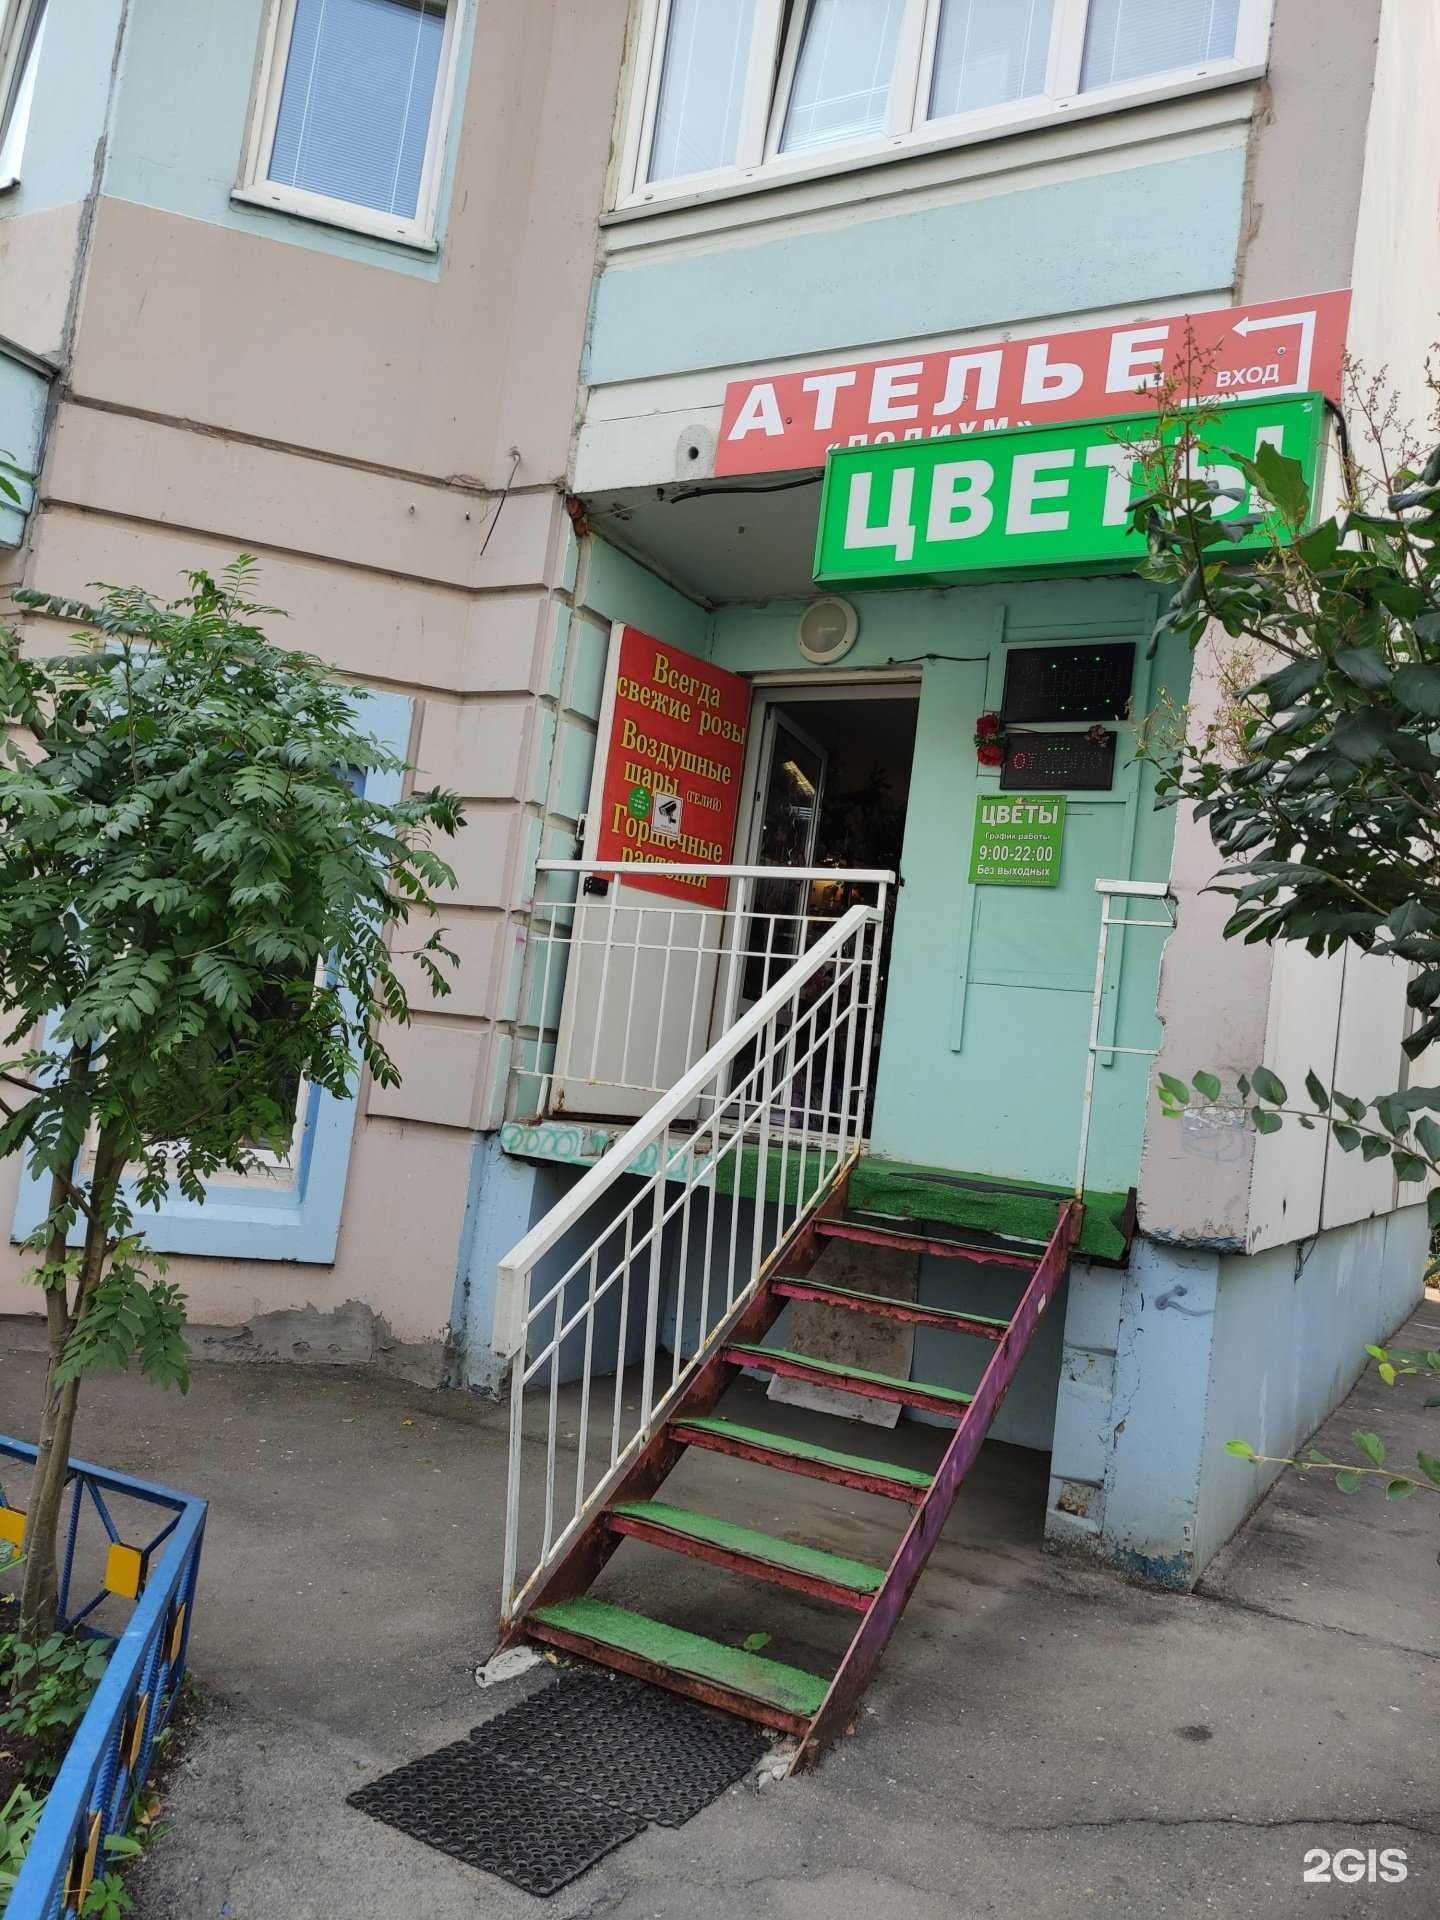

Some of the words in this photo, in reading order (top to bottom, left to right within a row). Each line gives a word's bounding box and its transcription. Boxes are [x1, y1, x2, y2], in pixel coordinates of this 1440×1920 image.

[727, 325, 1172, 441] АТЕЛЬЕ
[1216, 363, 1280, 388] ВХОД
[652, 653, 721, 708] Всегда
[616, 676, 691, 723] свежие
[699, 710, 746, 744] розы
[620, 718, 732, 784] Воздушные
[623, 760, 679, 797] шары
[981, 805, 1059, 826] ЦВЕТЫ
[985, 832, 1016, 840] График
[1018, 832, 1050, 840] работы
[979, 844, 1053, 862] 9:00-22:00
[977, 865, 994, 875] Без
[997, 867, 1050, 876] выходных
